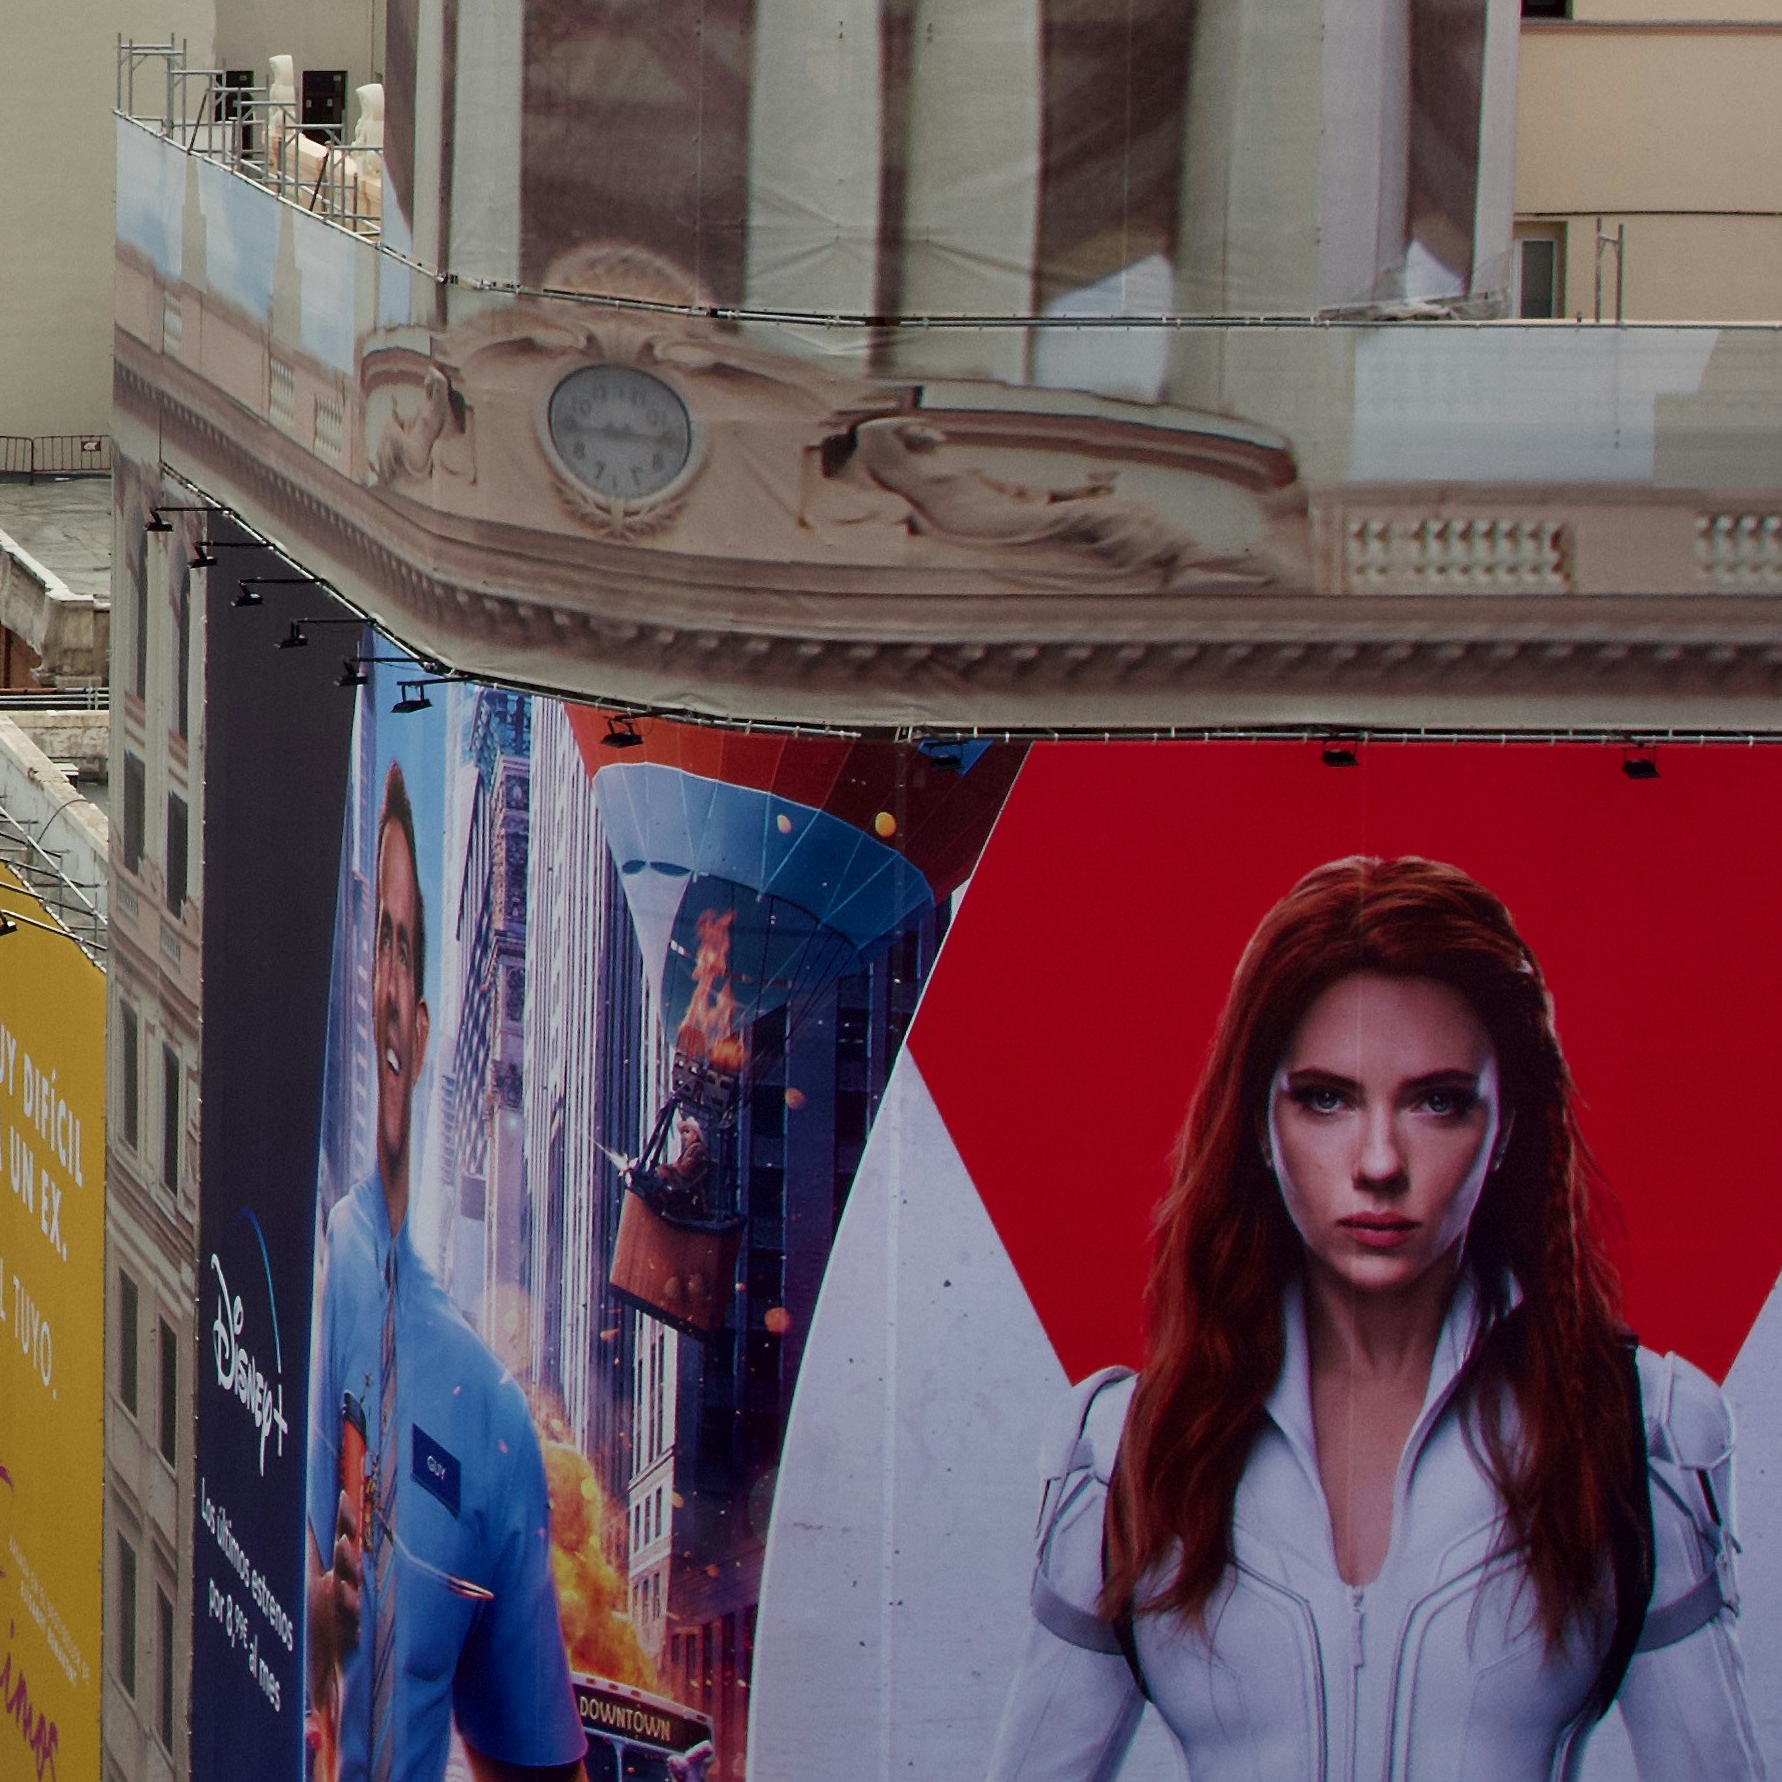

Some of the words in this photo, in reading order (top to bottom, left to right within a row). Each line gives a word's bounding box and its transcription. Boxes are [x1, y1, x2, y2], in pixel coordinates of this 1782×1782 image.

[23, 1053, 84, 1188] DIFÍCIL
[9, 1126, 34, 1215] UN
[40, 1169, 68, 1263] EX.
[13, 1275, 58, 1400] TUYO.
[201, 1478, 215, 1535] Los
[216, 1517, 250, 1587] últimos
[251, 1568, 293, 1652] estrenos
[208, 1578, 225, 1624] por
[226, 1594, 248, 1649] 8,99€
[249, 1634, 258, 1678] al
[259, 1658, 281, 1712] mes
[578, 1695, 672, 1742] DOWNTOWN
